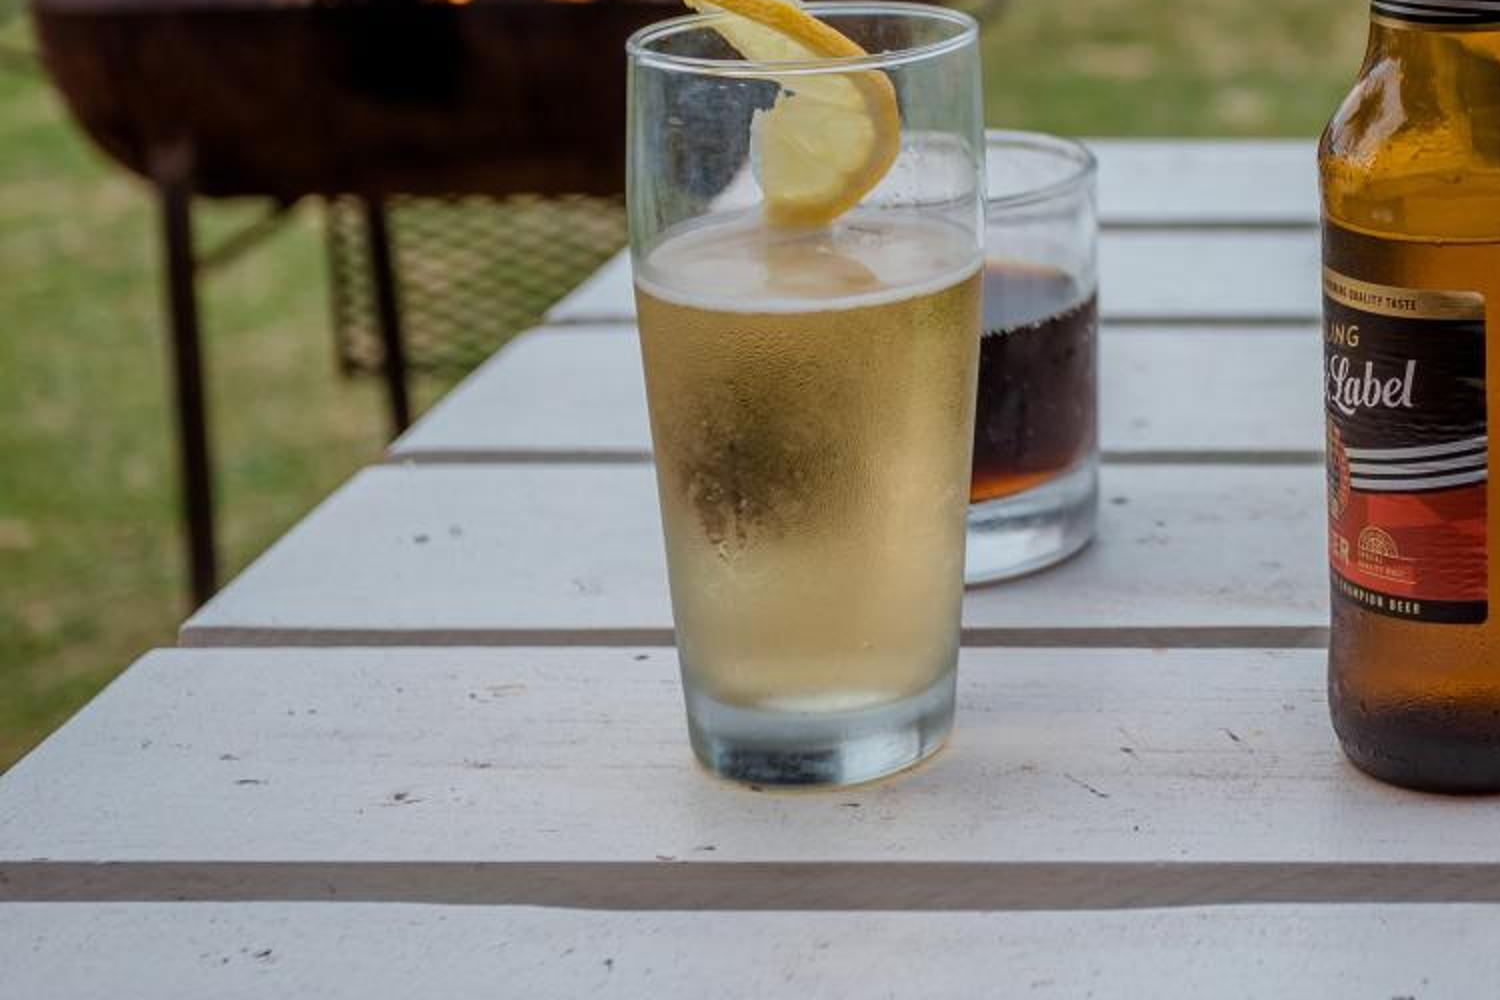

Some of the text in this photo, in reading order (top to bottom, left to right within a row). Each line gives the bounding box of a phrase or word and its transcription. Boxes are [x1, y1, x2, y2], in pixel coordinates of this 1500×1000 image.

[1386, 297, 1417, 311] TASTE
[1328, 321, 1360, 347] ING
[1329, 354, 1417, 415] Label
[1389, 599, 1420, 615] BEER
